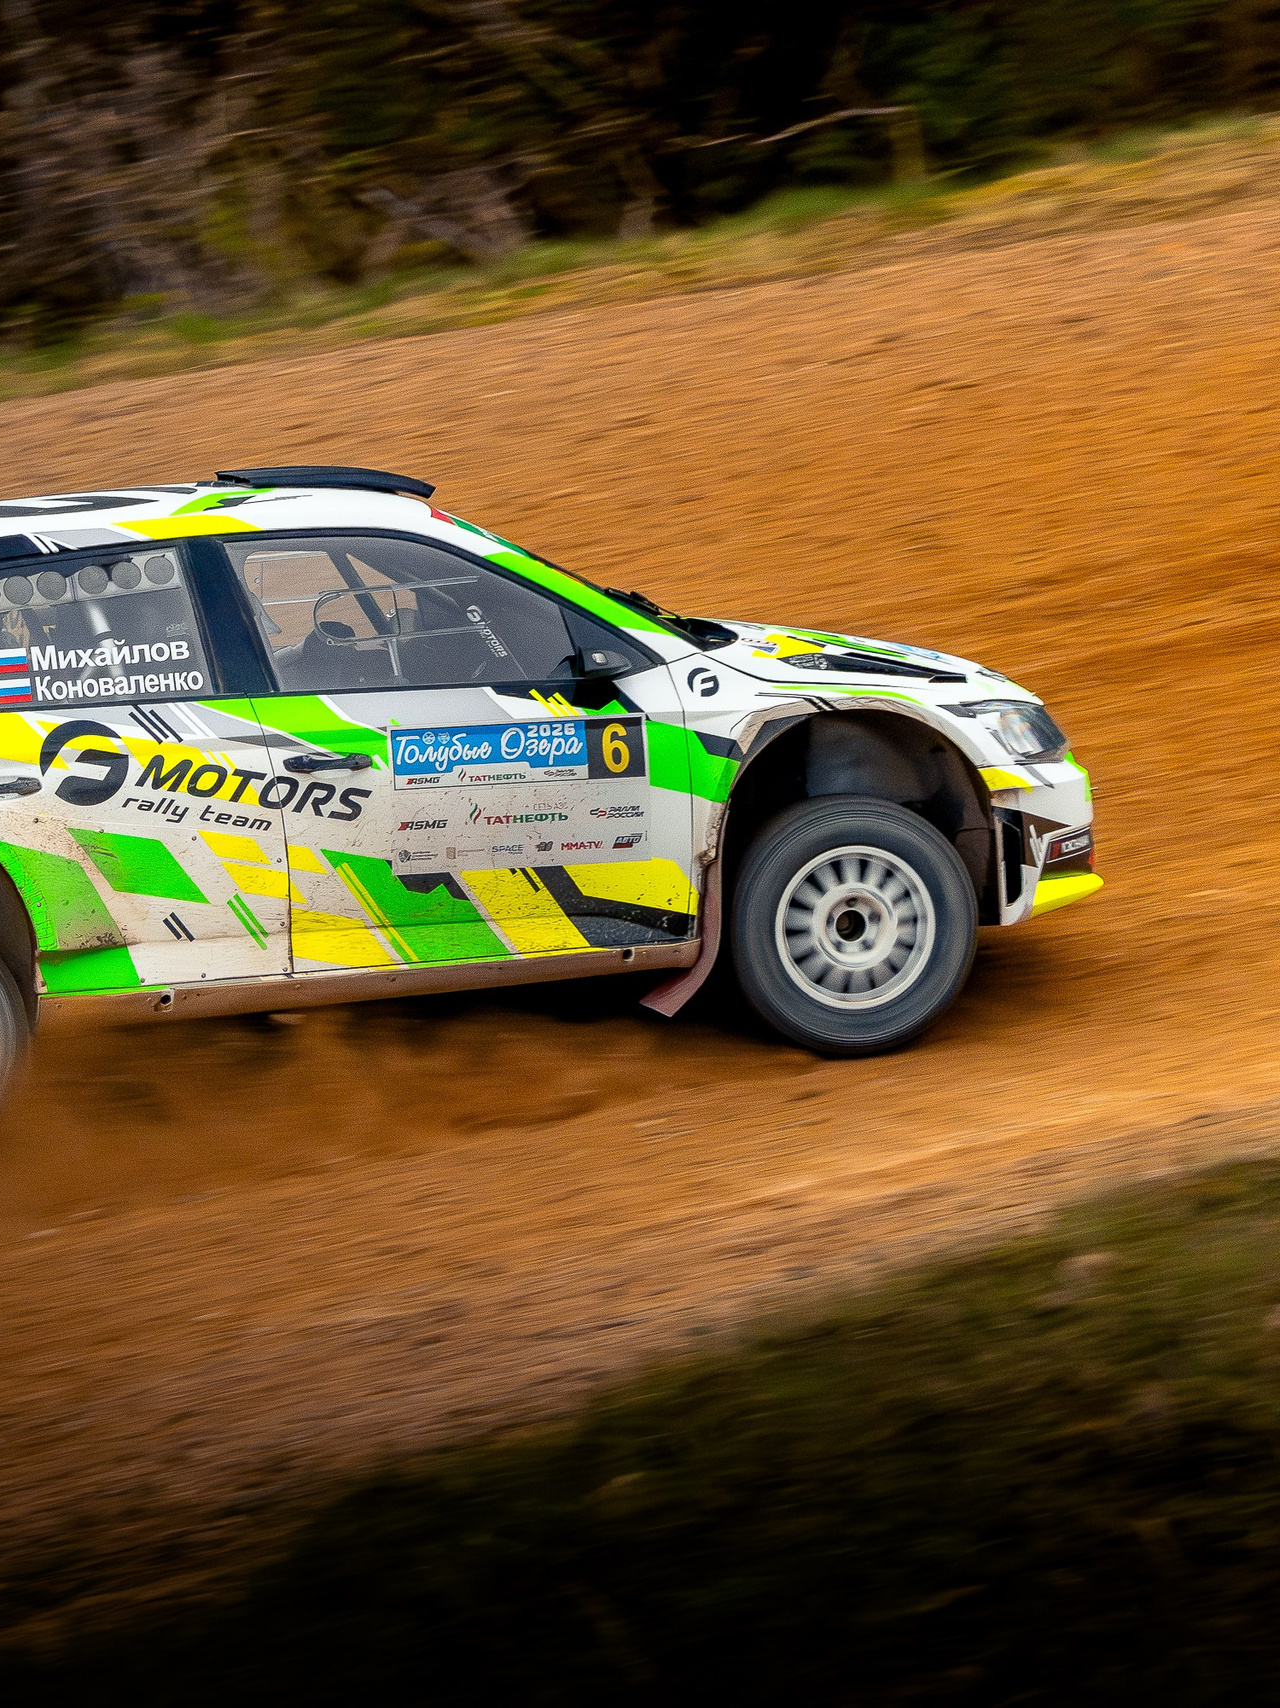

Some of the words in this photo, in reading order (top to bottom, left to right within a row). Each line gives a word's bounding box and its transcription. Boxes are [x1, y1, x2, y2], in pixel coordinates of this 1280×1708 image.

[30, 638, 191, 672] Михайлов
[35, 670, 204, 702] Коноваленко
[501, 727, 584, 766] Озера
[526, 723, 576, 738] 2026
[601, 722, 630, 773] 6
[134, 754, 373, 822] MOTORS
[468, 772, 527, 782] ТАТНЕФТЬ
[122, 796, 191, 824] rally
[199, 804, 273, 832] team
[484, 812, 569, 825] ТАТНЕФТЬ
